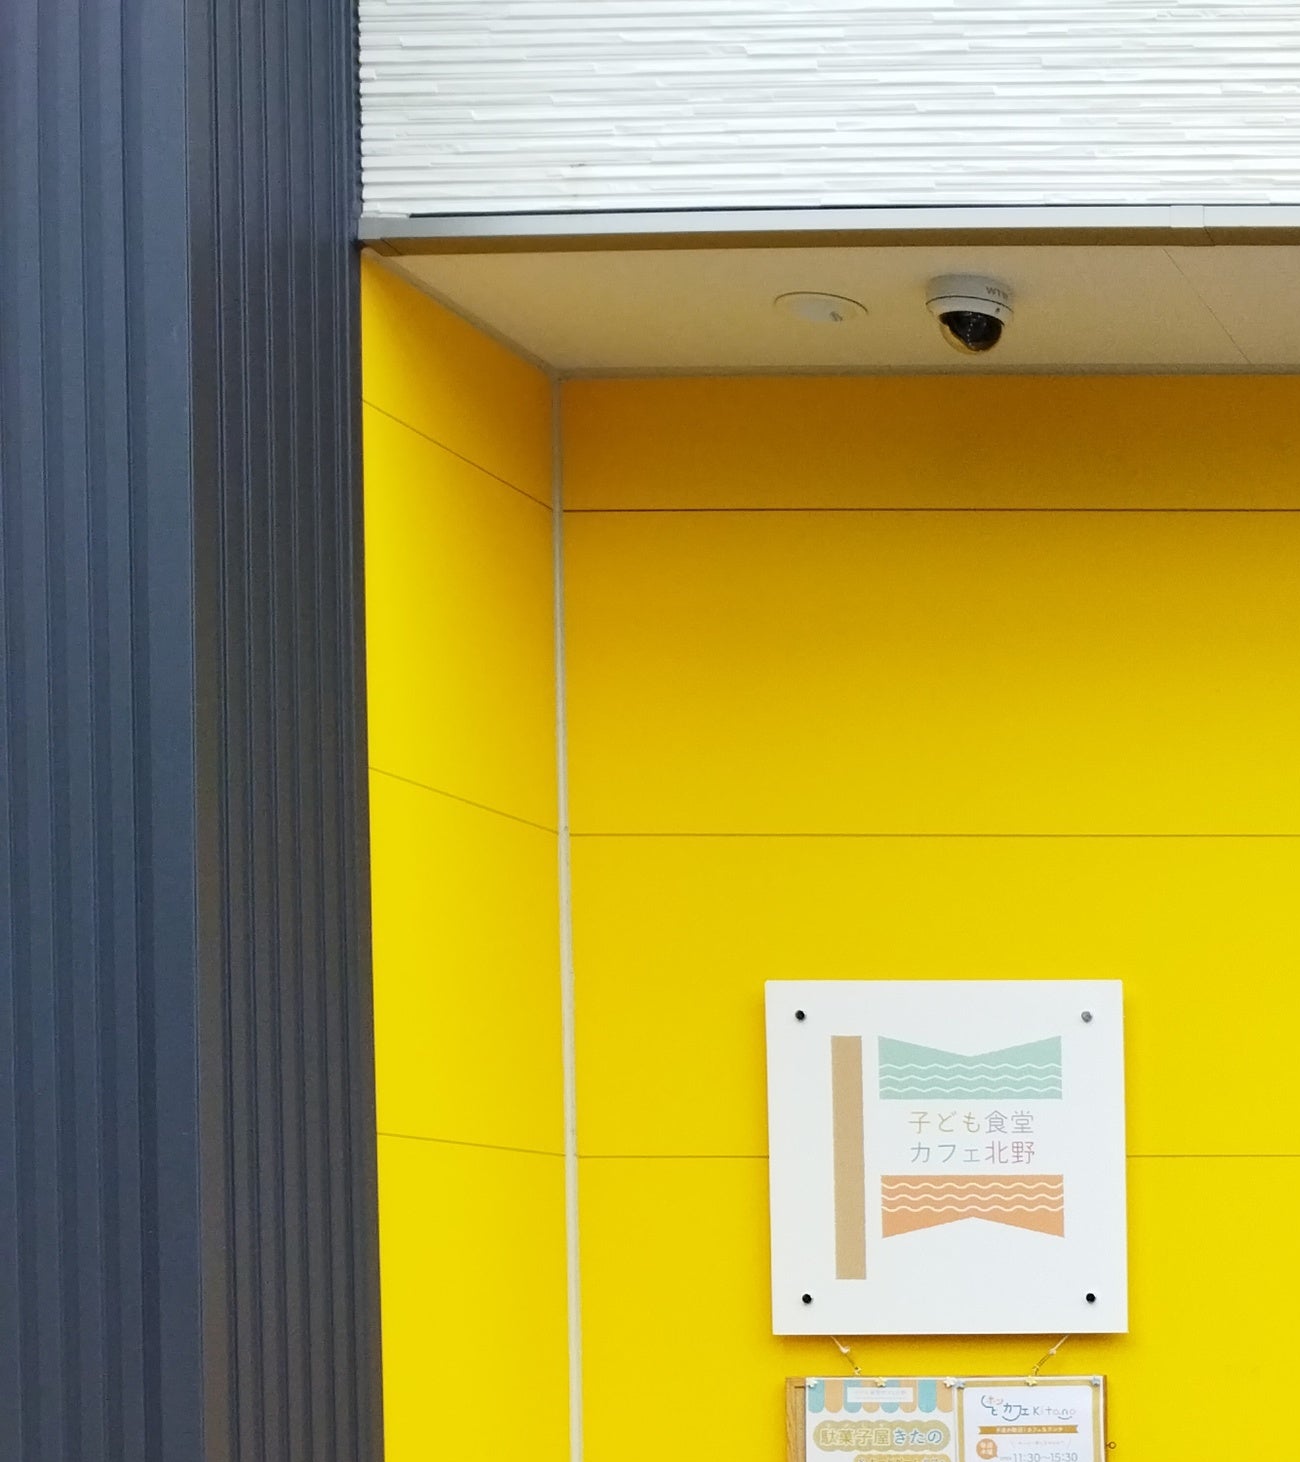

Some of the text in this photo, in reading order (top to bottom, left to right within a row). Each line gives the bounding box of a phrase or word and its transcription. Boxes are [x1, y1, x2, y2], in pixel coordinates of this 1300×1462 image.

[908, 1110, 1035, 1135] 子ども食堂
[910, 1140, 1036, 1165] カフェ北野
[819, 1427, 944, 1447] 駄菓子屋きたの
